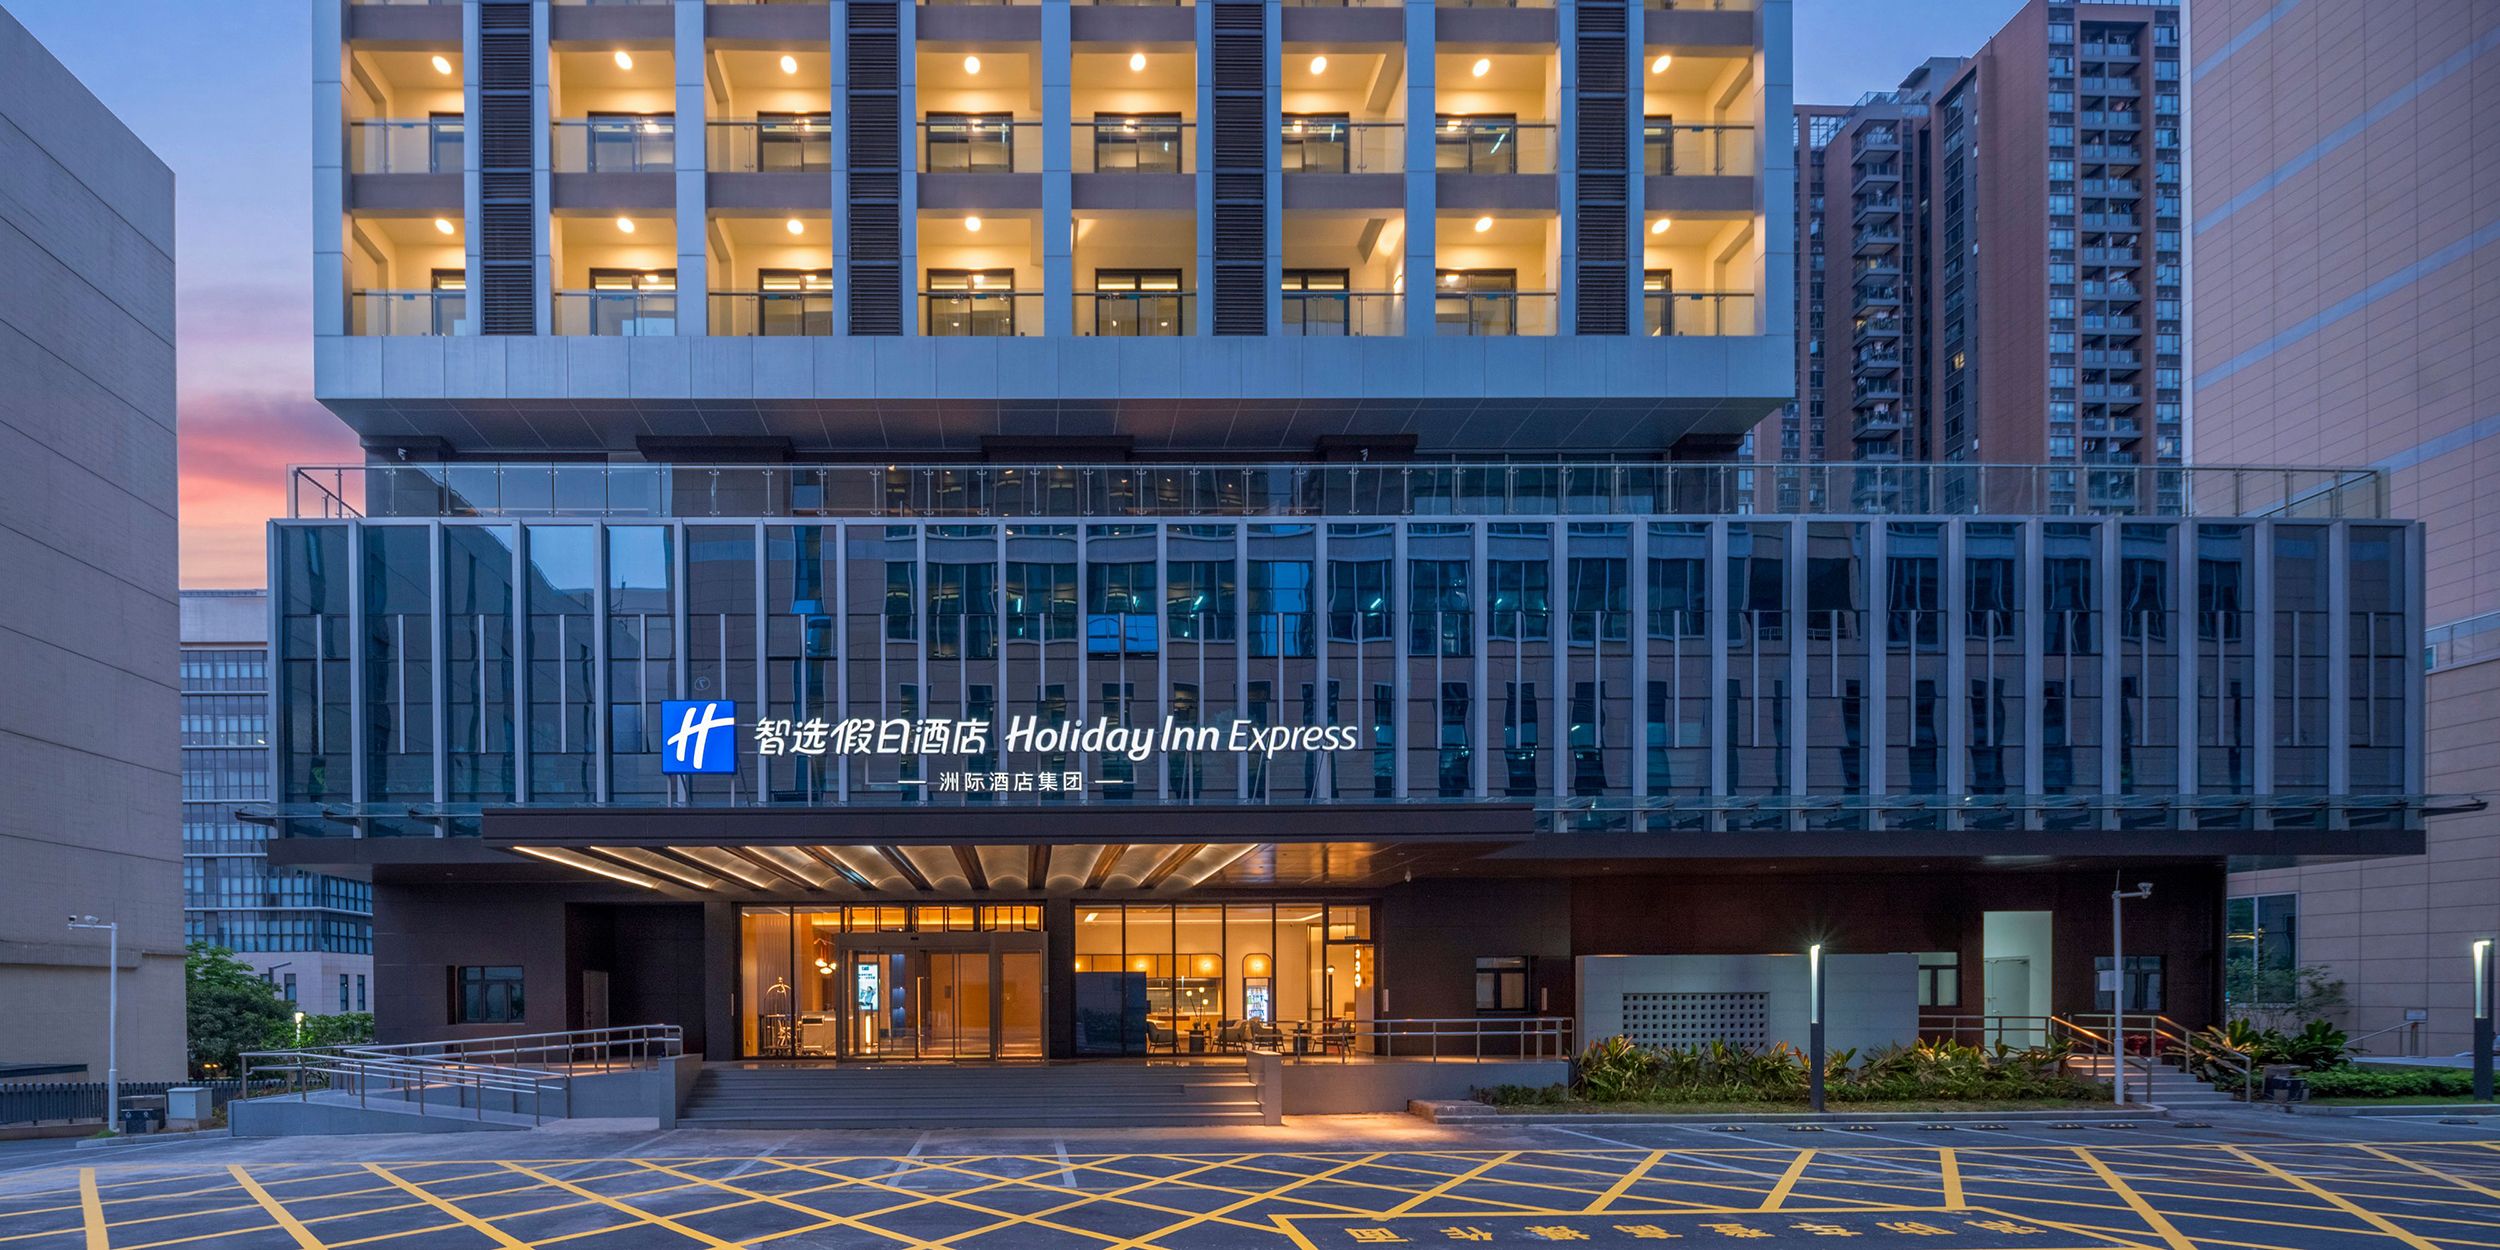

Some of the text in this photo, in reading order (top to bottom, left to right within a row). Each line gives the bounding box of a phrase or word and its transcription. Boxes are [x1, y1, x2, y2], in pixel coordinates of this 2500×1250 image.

[753, 716, 990, 756] 智选假日酒店
[1004, 715, 1358, 761] Holiday Inn Express
[939, 771, 1082, 792] 洲际酒店集团
[1345, 1220, 2048, 1243] 消防车登高操作面
